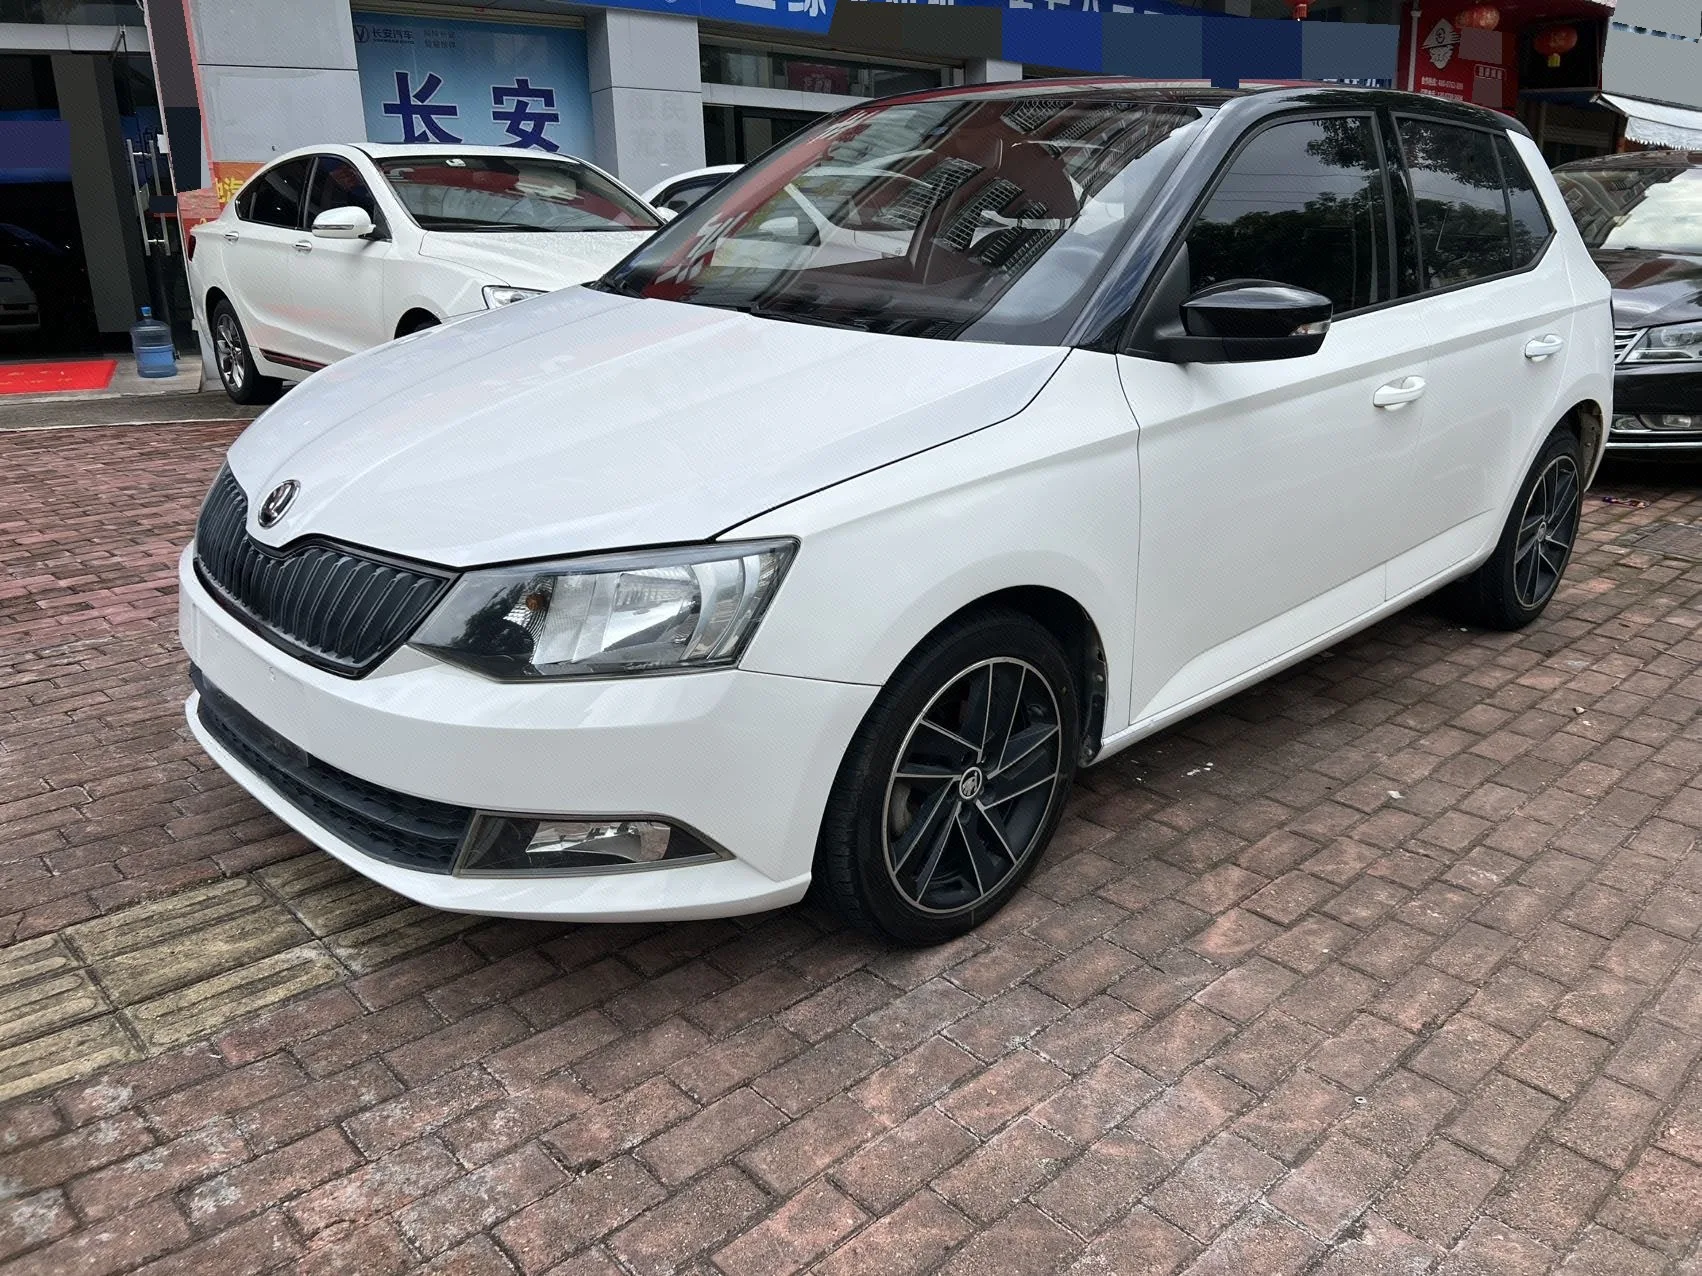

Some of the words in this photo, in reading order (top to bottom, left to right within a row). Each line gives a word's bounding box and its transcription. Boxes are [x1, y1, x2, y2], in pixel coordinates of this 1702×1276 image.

[372, 28, 414, 40] 长安汽车
[382, 71, 560, 153] 长安
